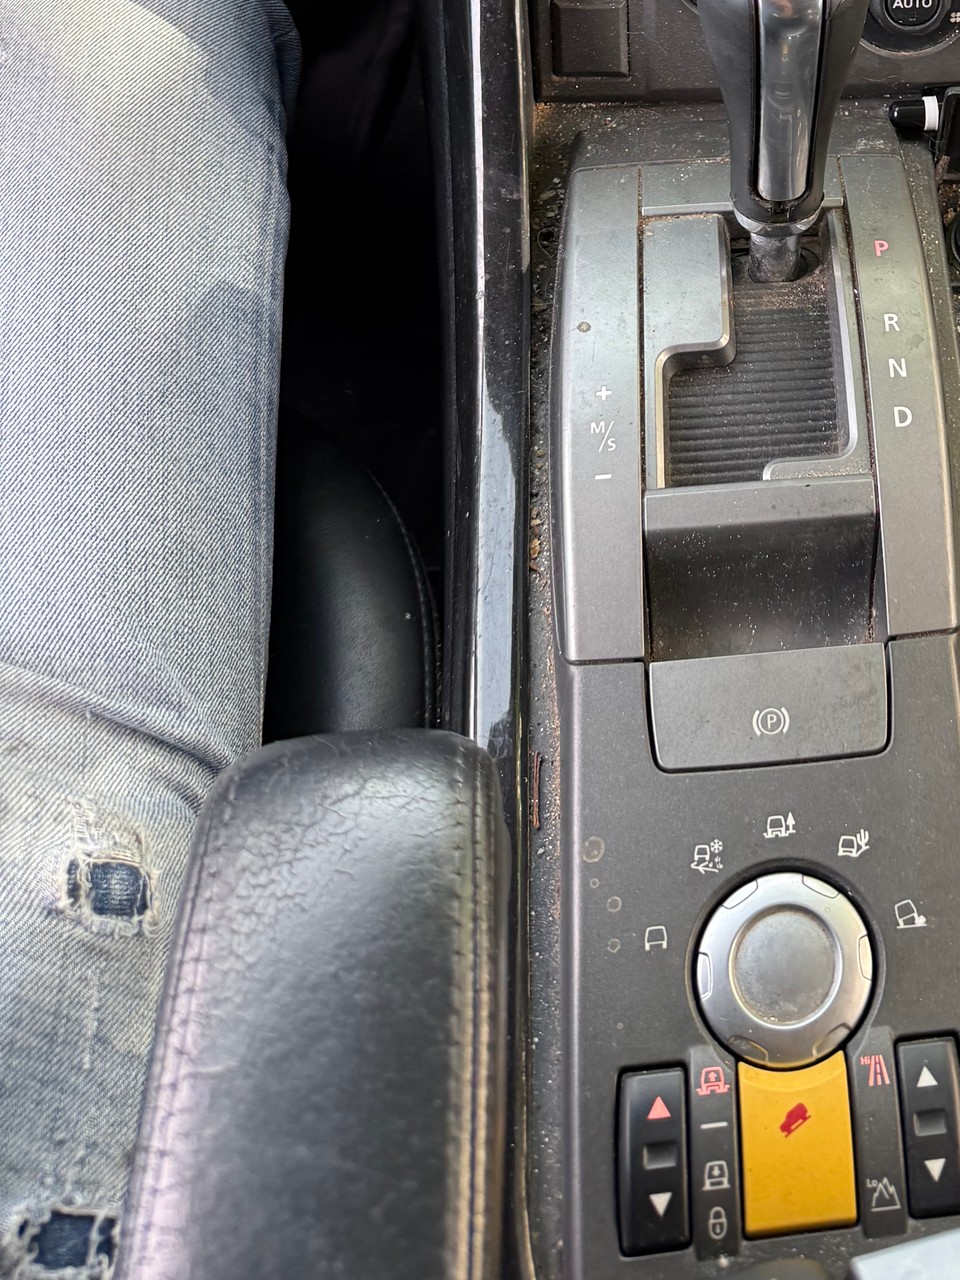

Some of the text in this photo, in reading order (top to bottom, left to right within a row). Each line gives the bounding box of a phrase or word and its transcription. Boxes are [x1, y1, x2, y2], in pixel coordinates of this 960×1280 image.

[874, 240, 889, 257] P
[884, 313, 901, 331] R
[889, 358, 908, 378] N
[894, 407, 913, 427] D
[860, 1055, 871, 1066] Hi
[866, 1177, 878, 1189] Lo
